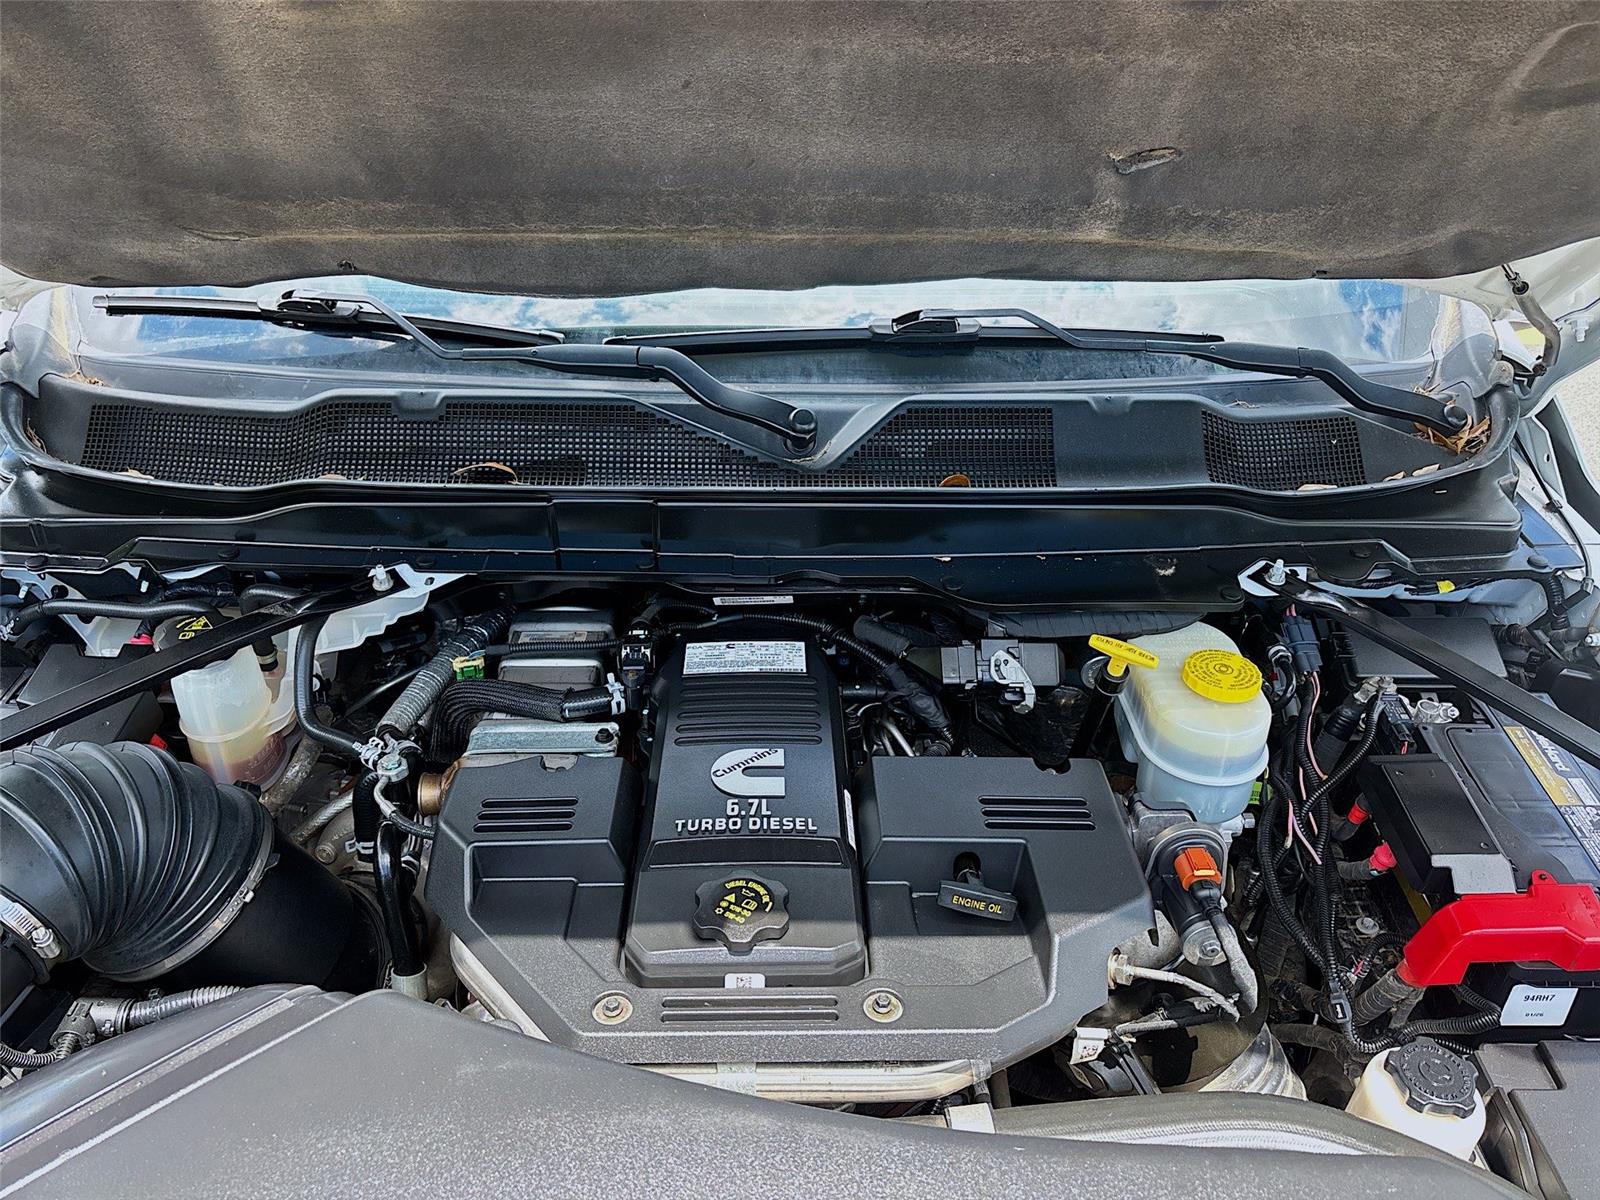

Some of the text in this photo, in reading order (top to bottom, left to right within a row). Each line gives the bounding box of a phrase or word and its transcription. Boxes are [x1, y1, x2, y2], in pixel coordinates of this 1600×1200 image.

[712, 748, 779, 778] Cummins
[726, 799, 772, 816] 6.7L
[675, 817, 818, 834] TURBO DIESEL
[952, 895, 1003, 914] ENGINE OIL
[1524, 994, 1556, 1002] 94RH7
